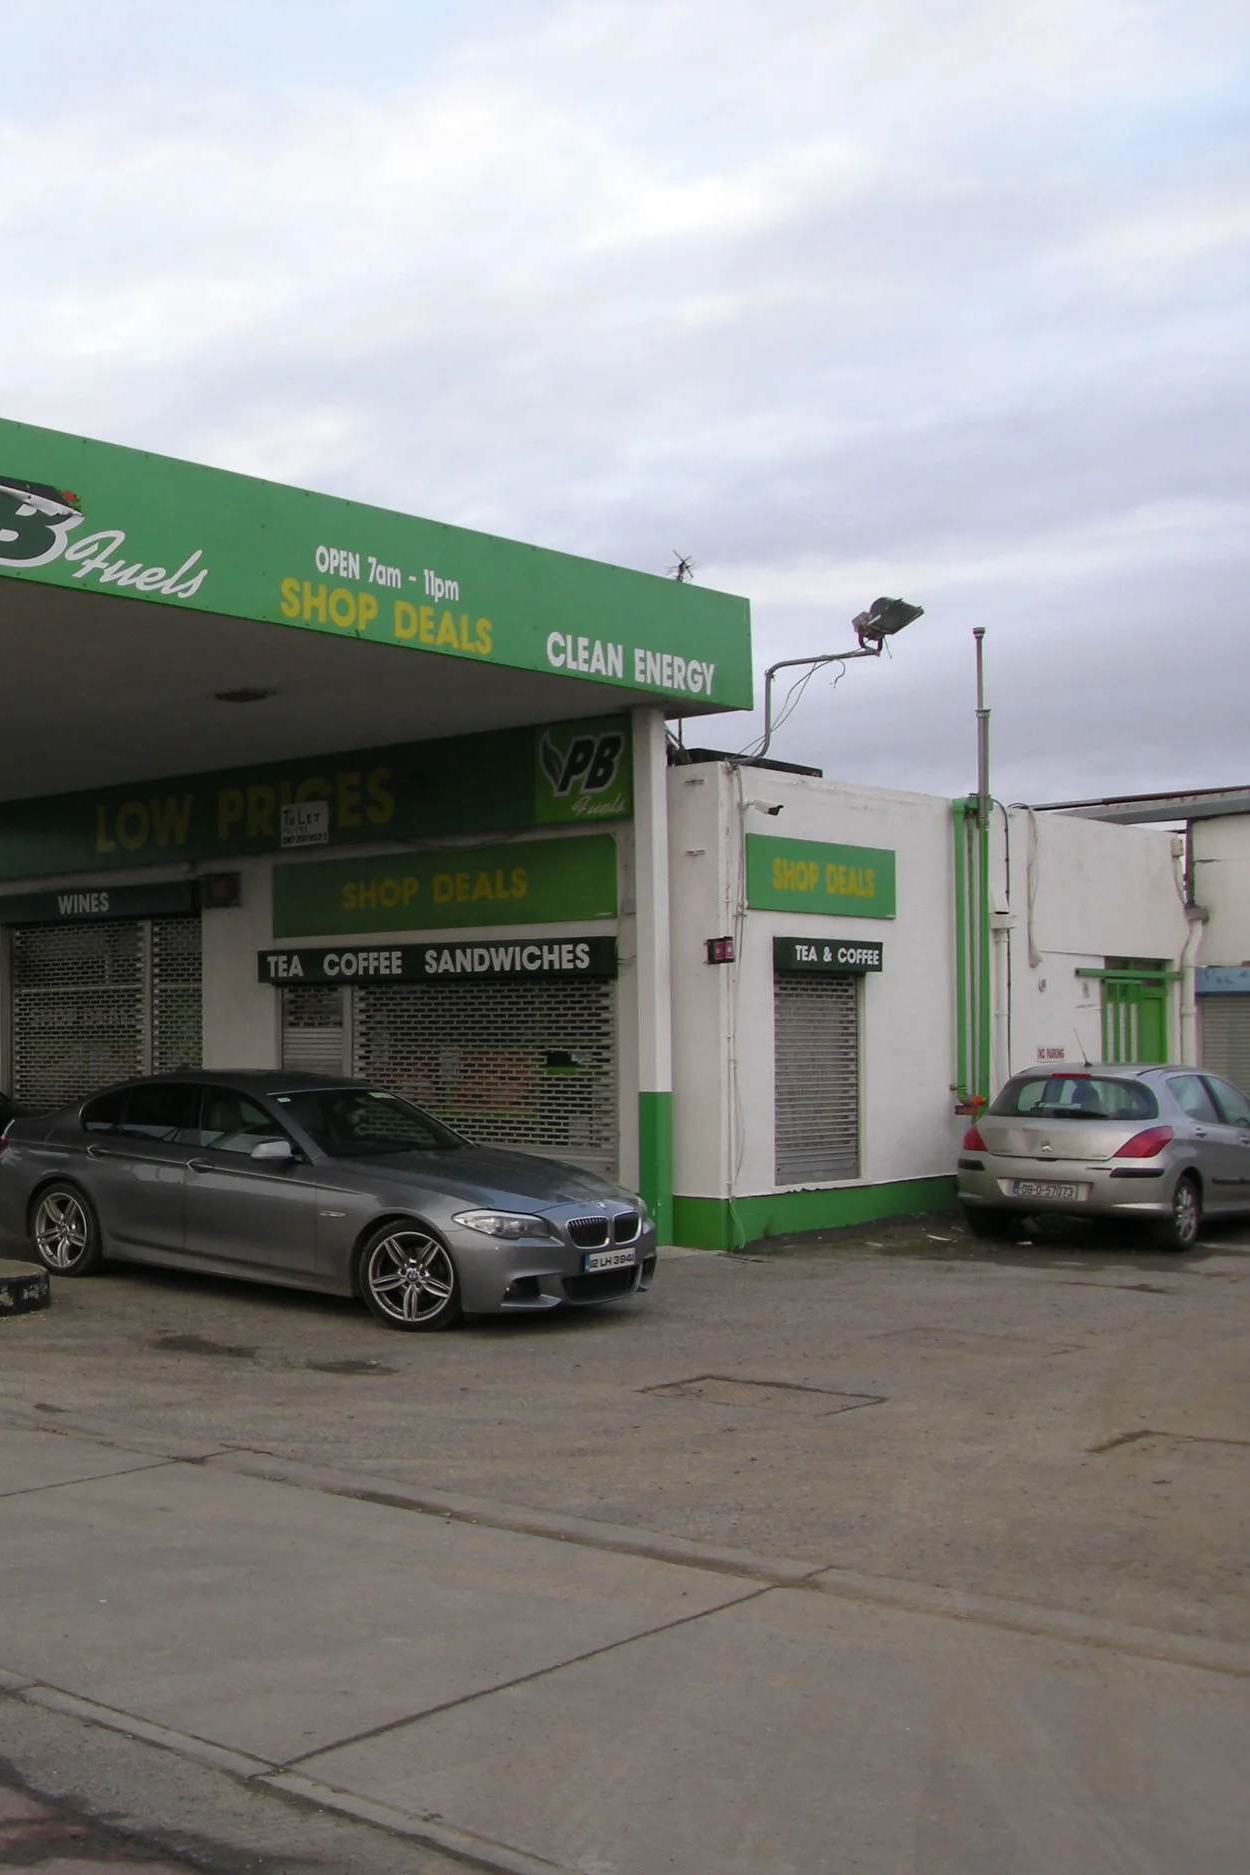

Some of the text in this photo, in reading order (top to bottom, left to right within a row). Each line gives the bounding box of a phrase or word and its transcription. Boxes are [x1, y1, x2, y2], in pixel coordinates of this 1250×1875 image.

[65, 530, 208, 599] Fuels
[315, 545, 360, 581] OPEN
[367, 556, 401, 588] 7am
[423, 568, 459, 603] 11pm
[280, 577, 493, 656] SHOP DEALS
[546, 631, 715, 697] CLEAN ENERGY
[555, 732, 624, 796] PB
[96, 793, 195, 855] LOW
[58, 892, 109, 914] WINES
[343, 868, 527, 911] SHOP DEALS
[772, 858, 876, 899] SHOP DEALS
[267, 943, 590, 978] TEA COFFEE SANDWICHES
[795, 944, 880, 966] TEA & COFFEE
[1038, 1048, 1064, 1059] NO PARKING
